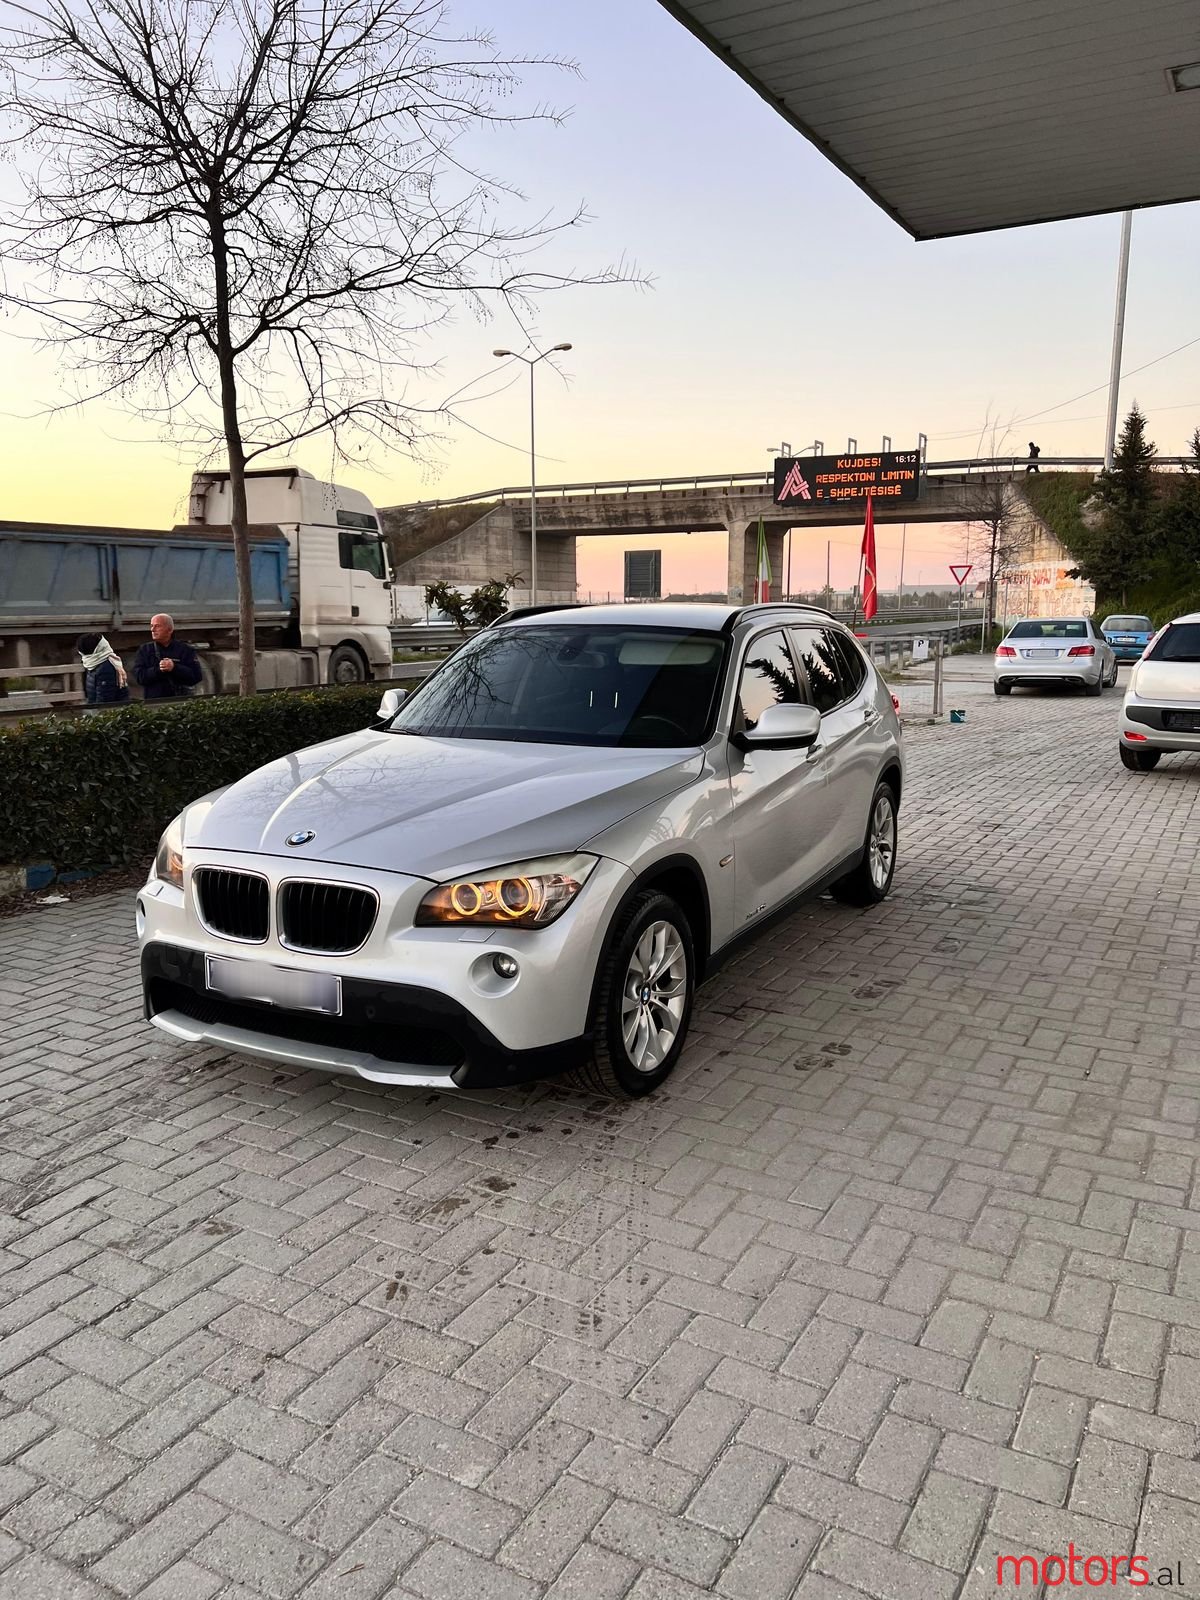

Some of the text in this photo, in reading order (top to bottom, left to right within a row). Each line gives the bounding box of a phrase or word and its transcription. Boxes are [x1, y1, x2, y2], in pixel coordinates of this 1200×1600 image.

[837, 457, 881, 468] KUJDES!
[815, 470, 915, 484] RESPEKTONI LIMITIN
[816, 488, 823, 498] E
